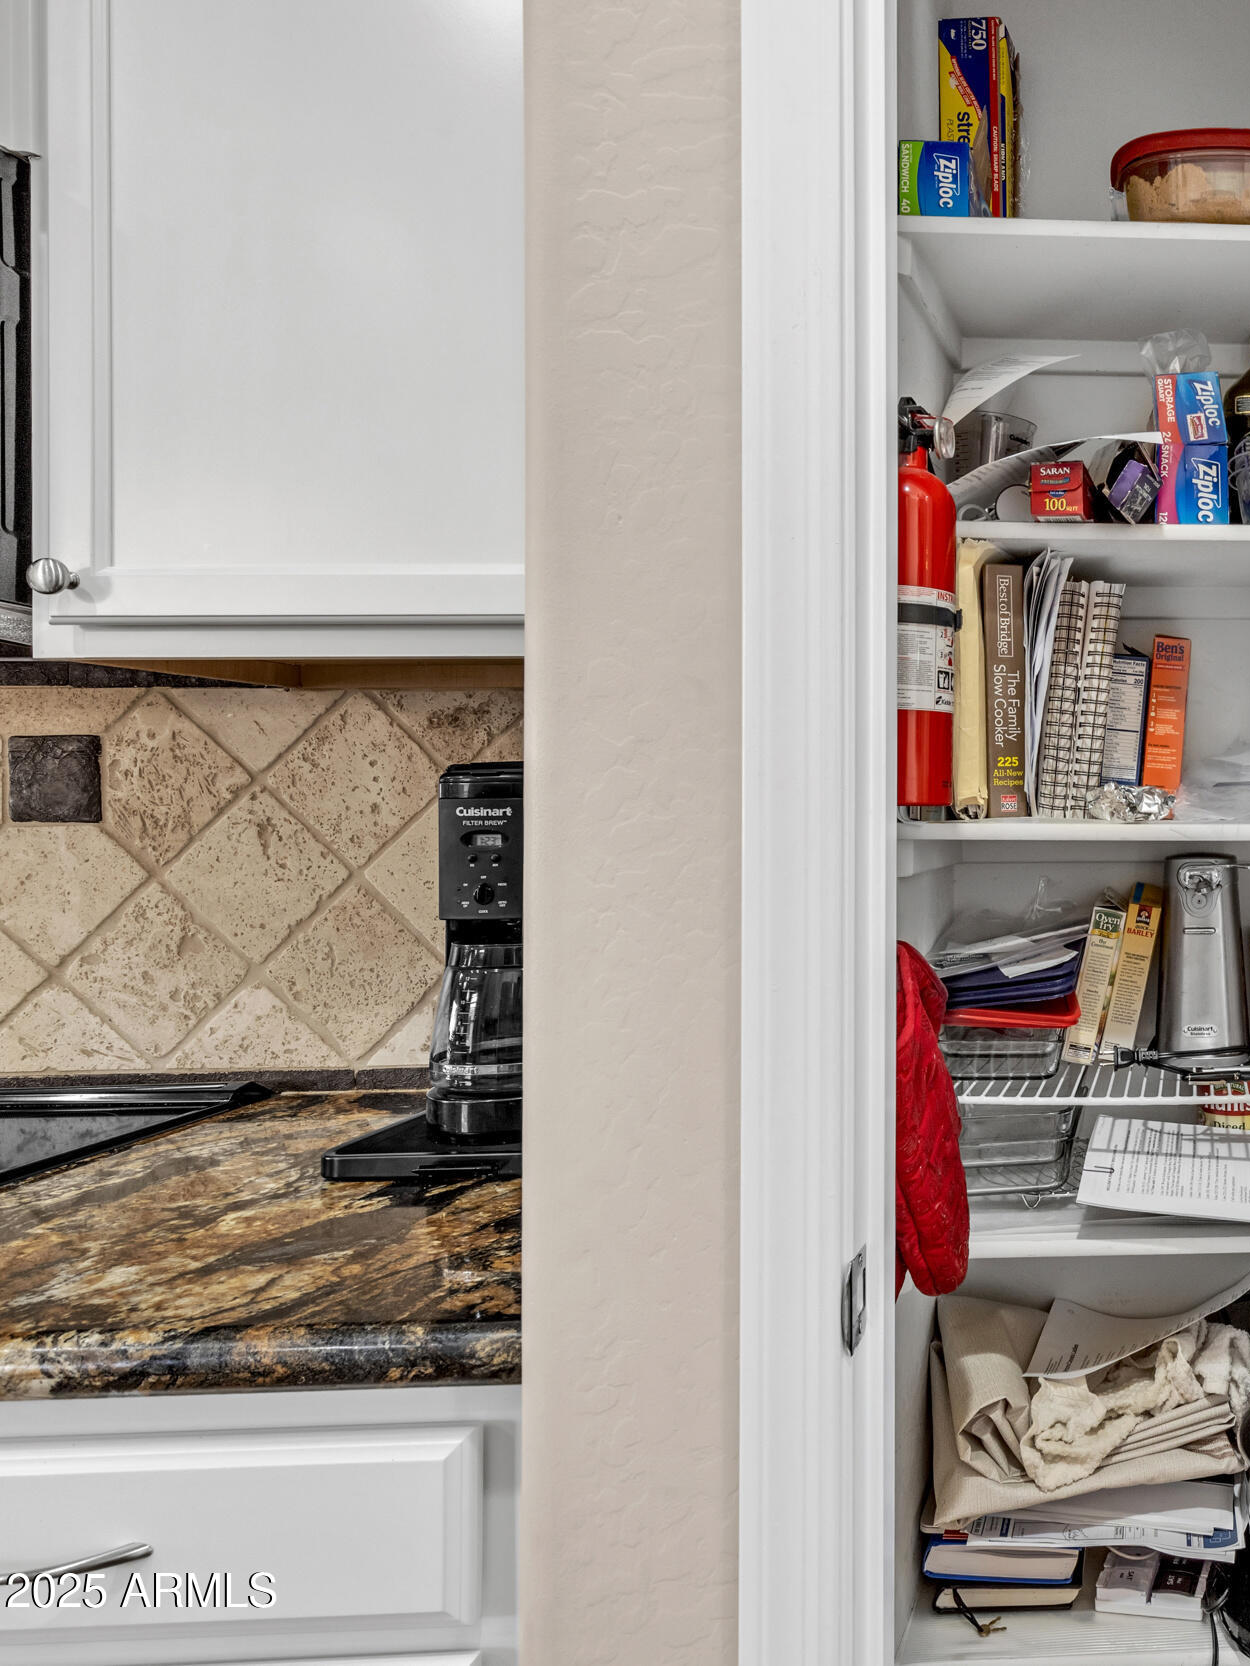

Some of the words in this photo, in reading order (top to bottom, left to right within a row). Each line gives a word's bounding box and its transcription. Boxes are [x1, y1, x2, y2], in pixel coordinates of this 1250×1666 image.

[971, 19, 987, 51] 750
[901, 143, 910, 193] SANDWICH
[934, 157, 956, 208] Ziploc
[901, 198, 911, 213] 40
[1157, 379, 1165, 402] QUART
[1163, 378, 1175, 423] STORAGE
[1193, 380, 1221, 427] Ziploc
[1040, 466, 1071, 476] SARAN
[1160, 443, 1170, 478] SNACK
[1192, 463, 1218, 523] Ziploc
[1044, 498, 1067, 511] 100
[999, 578, 1010, 599] Best
[1000, 602, 1011, 615] of
[997, 617, 1010, 655] Bridge
[1155, 652, 1184, 662] Original
[1156, 641, 1185, 655] Ben's
[994, 664, 1006, 696] Slow
[1008, 670, 1020, 695] The
[994, 699, 1007, 748] Cooker
[1005, 699, 1020, 742] Family
[997, 757, 1019, 767] 225
[993, 769, 1024, 778] All-New
[993, 778, 1024, 788] Recipes
[456, 806, 512, 816] Cuisinart
[1001, 803, 1017, 811] ROSE
[1096, 912, 1121, 925] Oven
[1126, 927, 1155, 938] BARLEY
